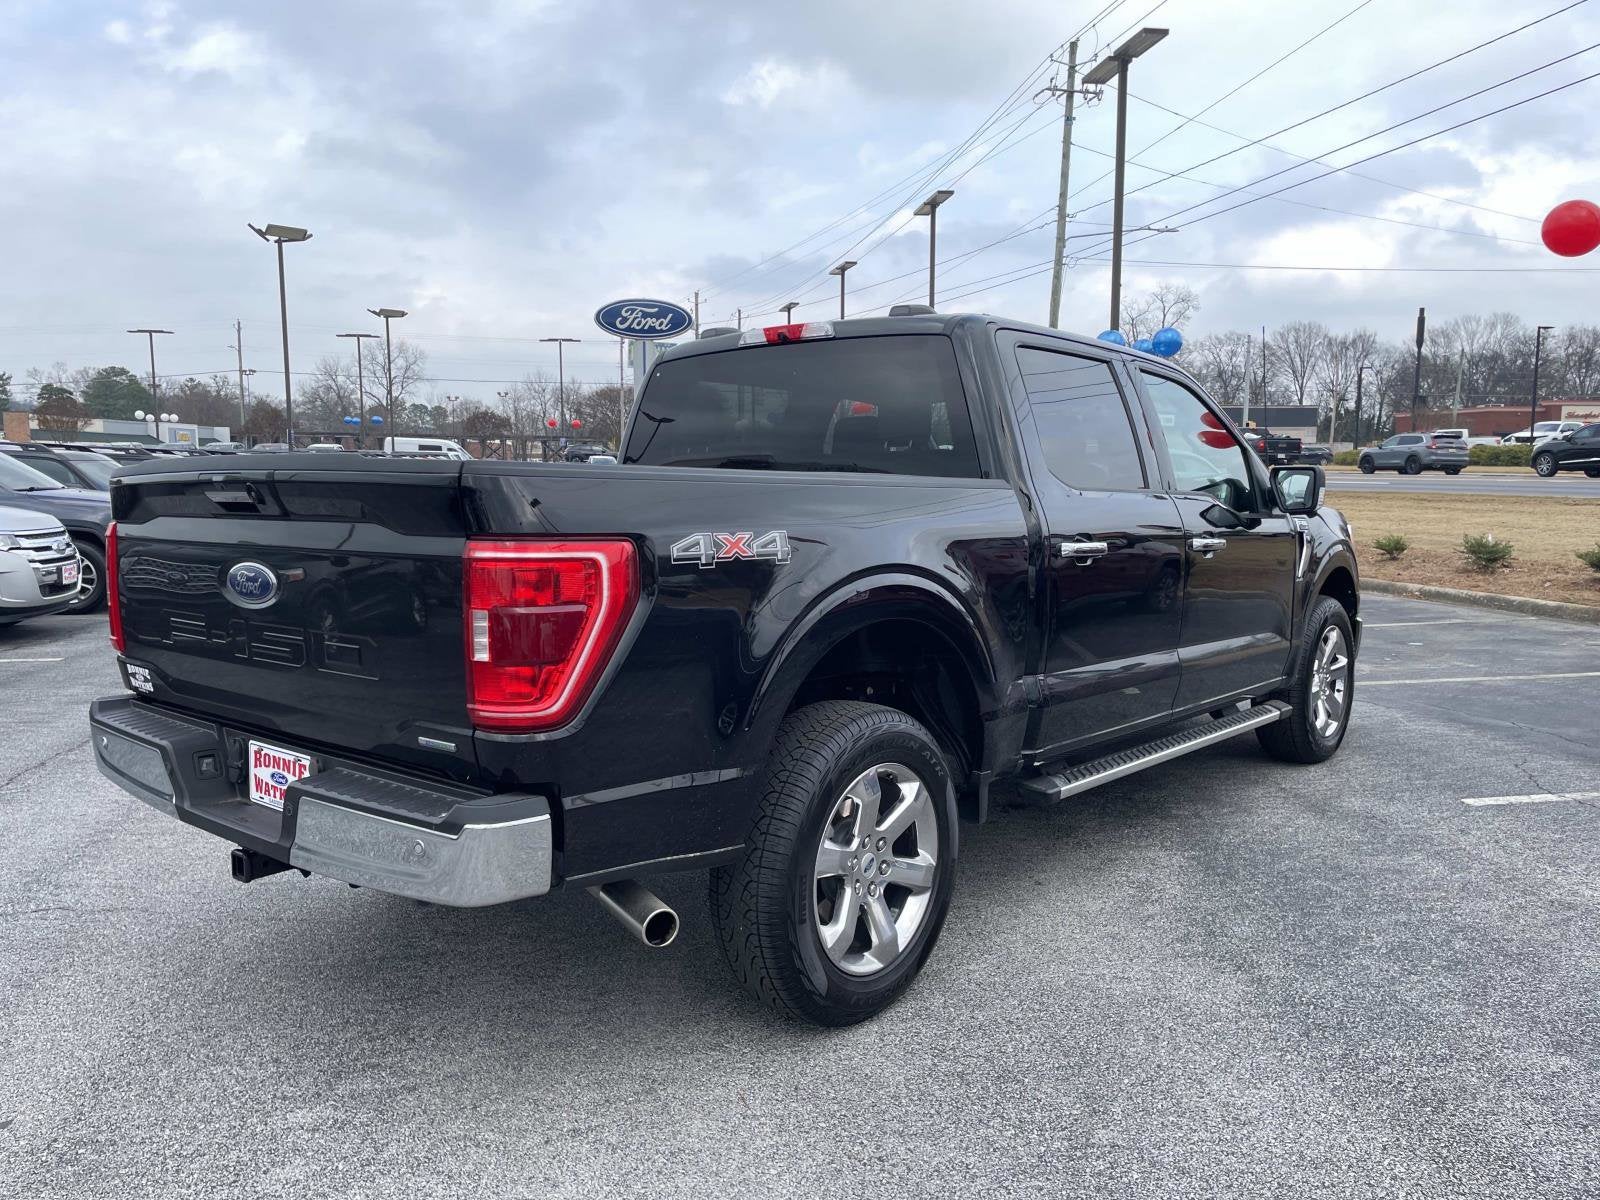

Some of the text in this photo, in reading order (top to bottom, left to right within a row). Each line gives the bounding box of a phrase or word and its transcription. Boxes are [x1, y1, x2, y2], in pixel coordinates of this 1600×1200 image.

[615, 305, 673, 330] Ford
[235, 570, 262, 594] Ford
[160, 609, 379, 680] F-150
[254, 750, 307, 780] RONNIE
[254, 774, 286, 800] WATK
